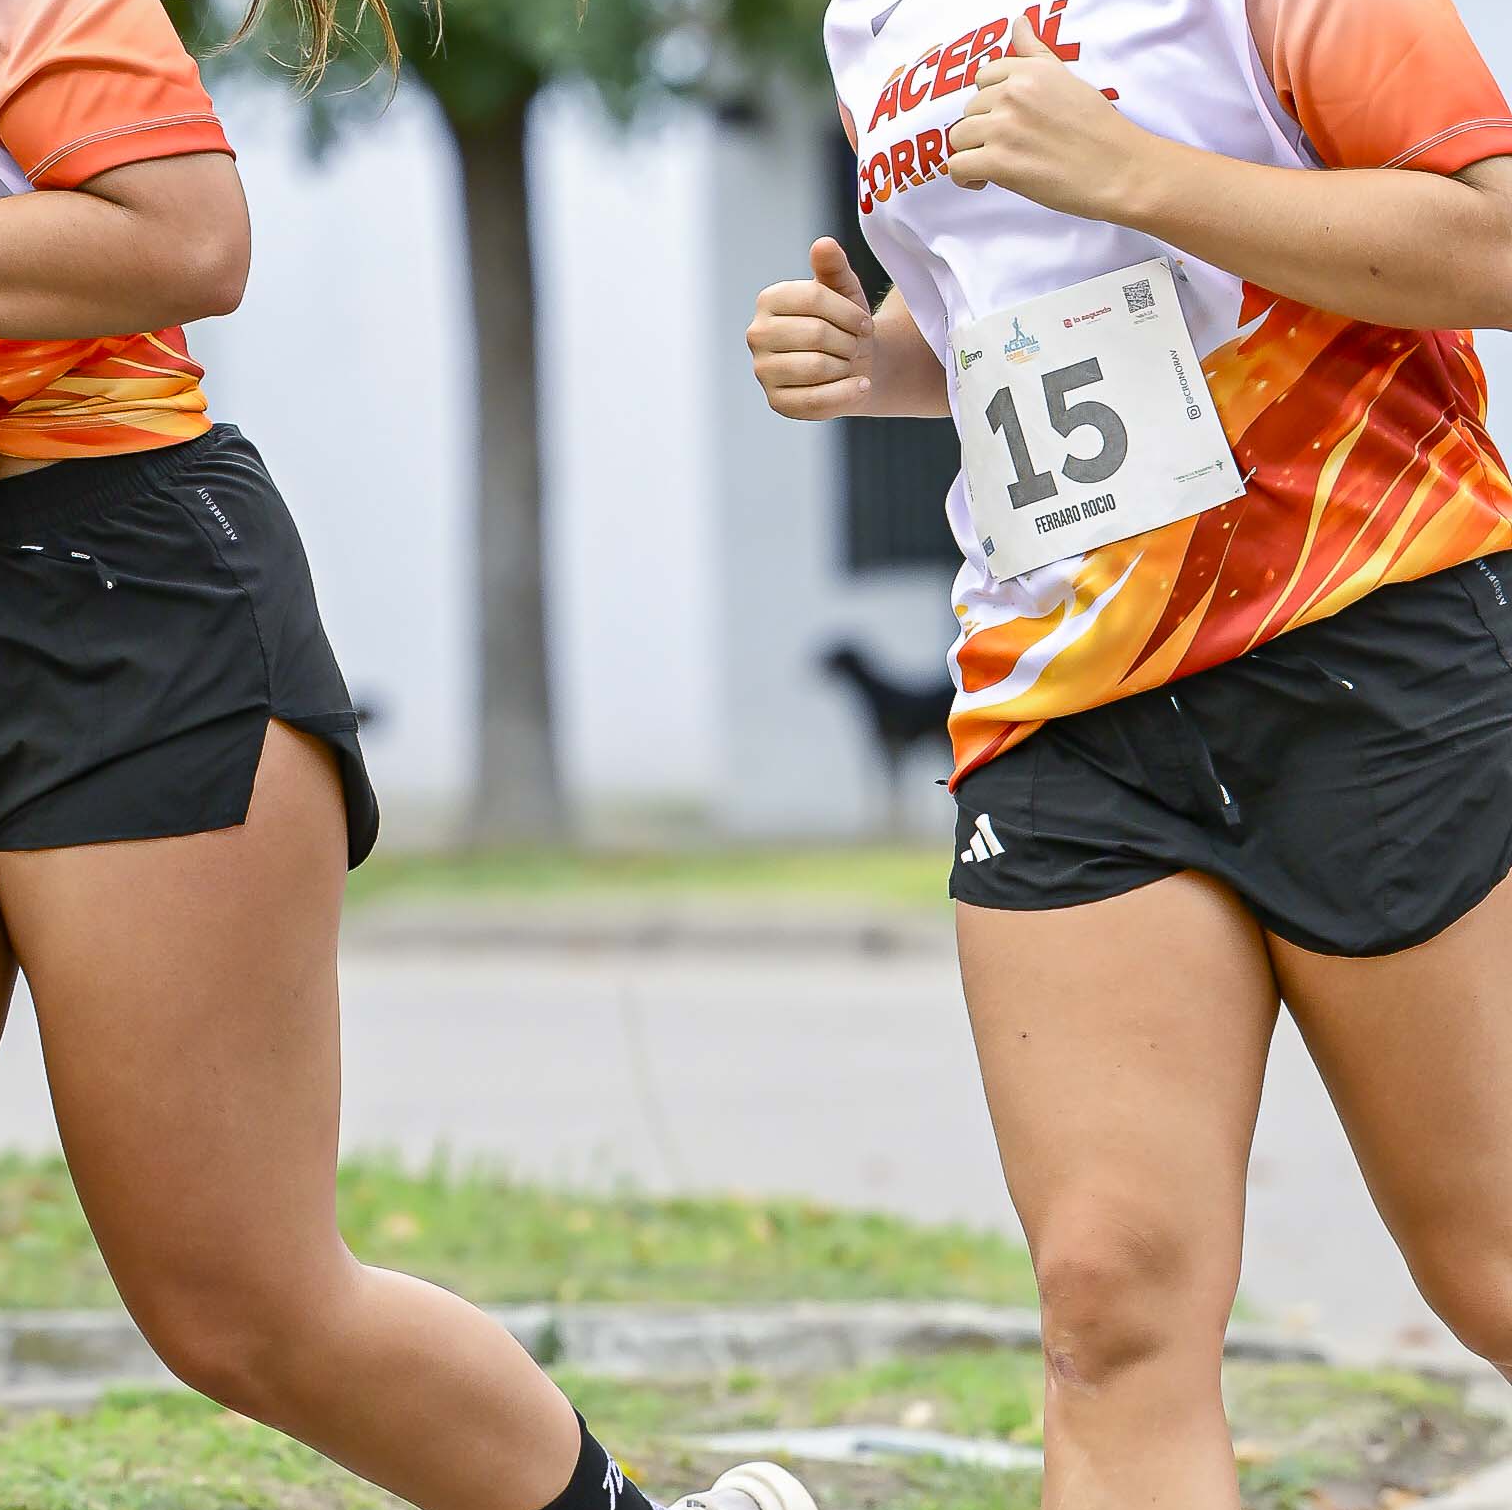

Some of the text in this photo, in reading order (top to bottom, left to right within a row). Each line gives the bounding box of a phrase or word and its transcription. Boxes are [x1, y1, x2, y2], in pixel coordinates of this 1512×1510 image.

[858, 117, 965, 215] CORR
[985, 356, 1129, 510] 15
[196, 487, 238, 541] AEROREADY
[1034, 493, 1117, 535] FERRARO ROCIO
